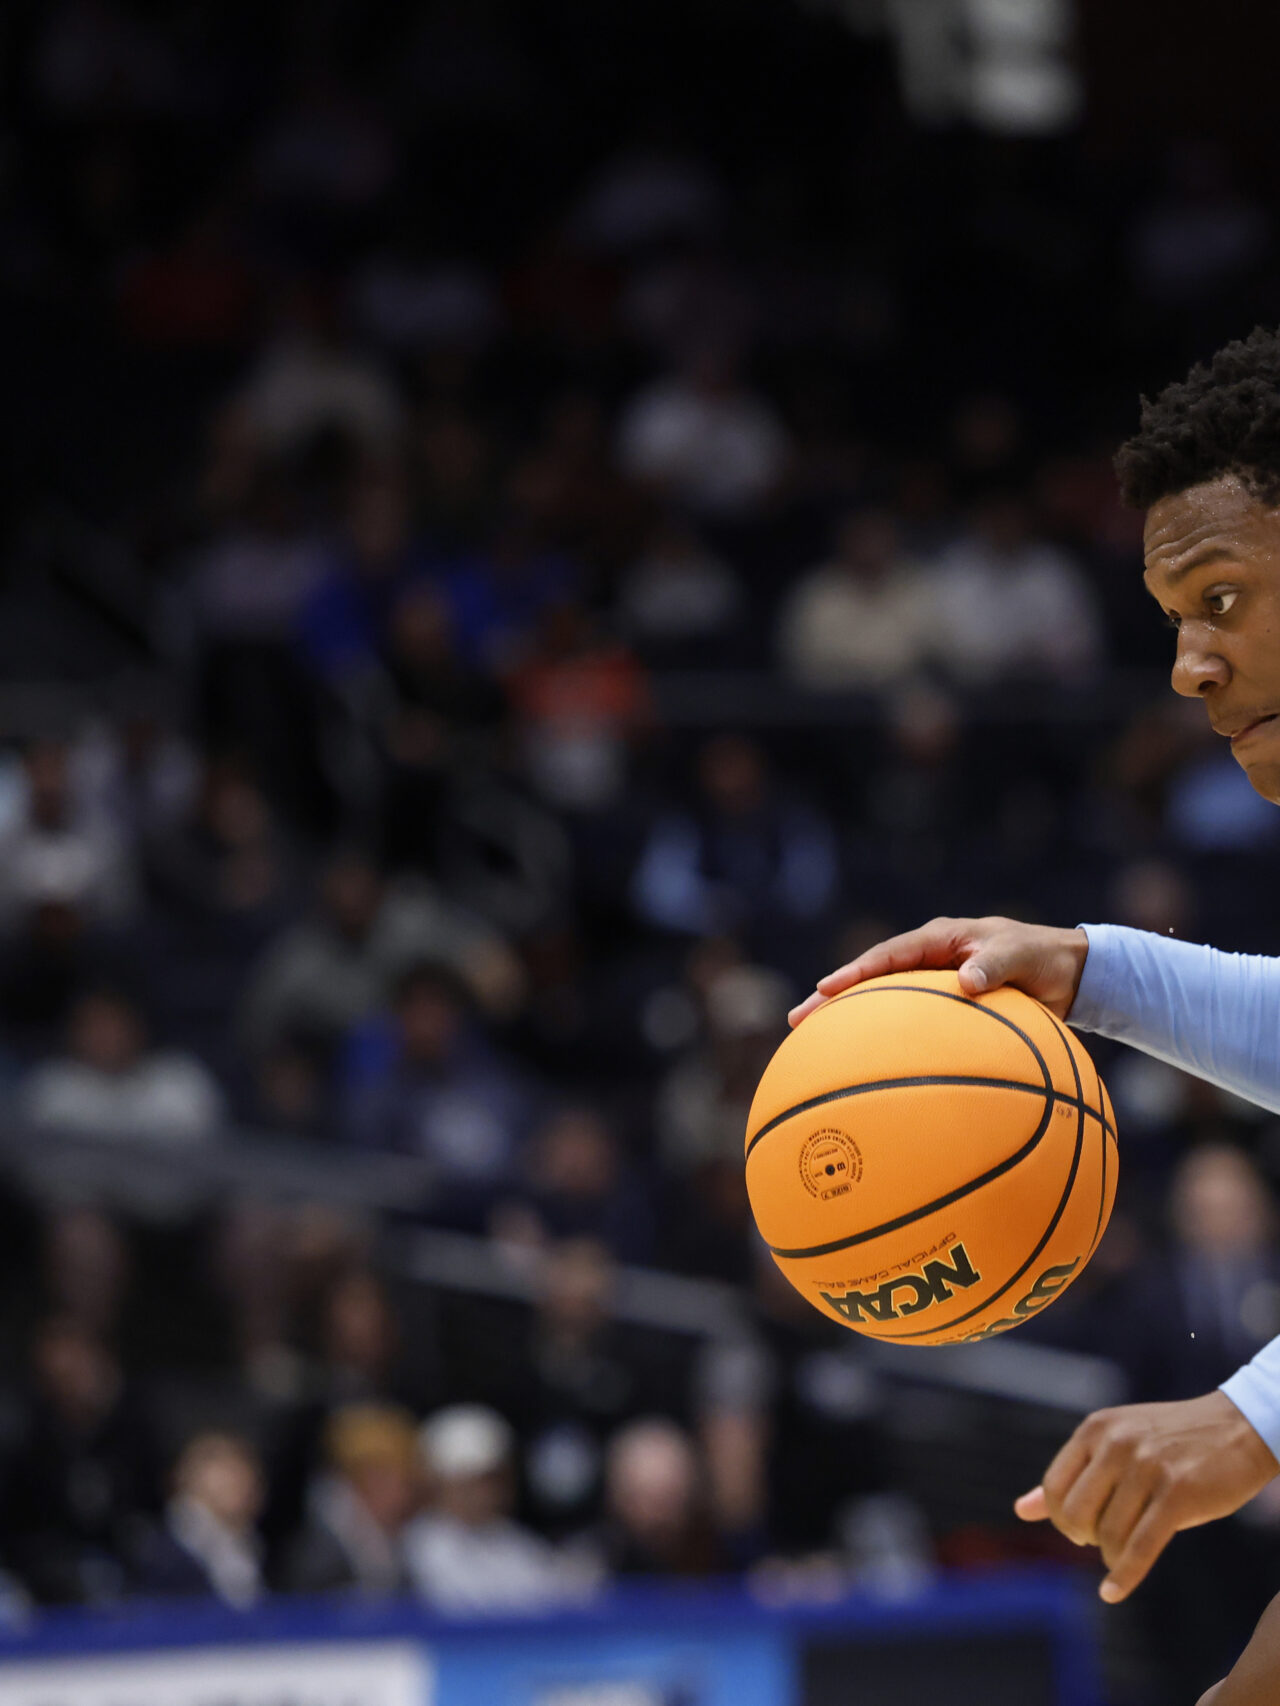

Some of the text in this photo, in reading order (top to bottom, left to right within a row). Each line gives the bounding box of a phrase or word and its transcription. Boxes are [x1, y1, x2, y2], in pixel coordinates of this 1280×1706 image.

[892, 1231, 957, 1271] OFFICIAL
[819, 1241, 982, 1323] NCAA
[847, 1270, 890, 1286] GAME
